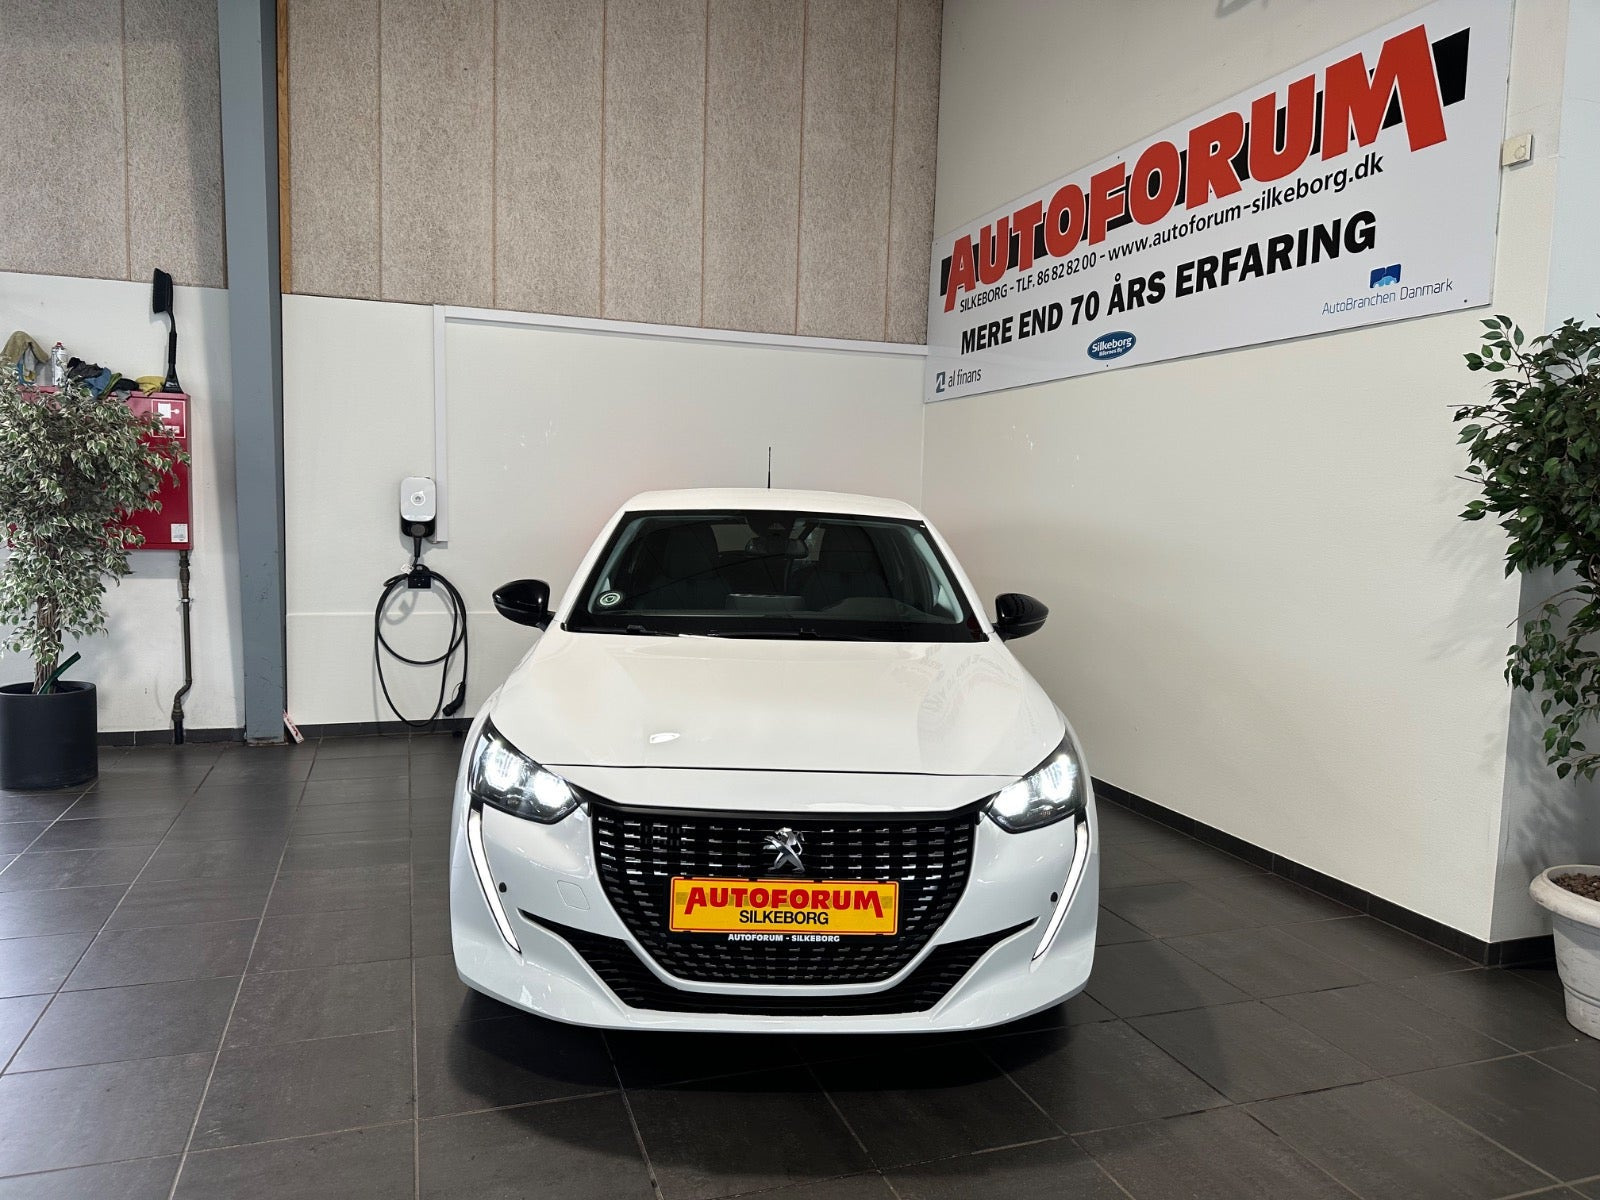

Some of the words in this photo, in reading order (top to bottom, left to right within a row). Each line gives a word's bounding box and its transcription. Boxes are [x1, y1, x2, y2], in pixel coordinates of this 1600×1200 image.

[944, 24, 1447, 314] AUTOFORUM
[960, 283, 1008, 313] SILKEBORG
[1016, 274, 1035, 293] TLF.
[1108, 152, 1384, 261] www.autoforum-silkeborg.dk
[960, 315, 1014, 355] MERE
[1018, 302, 1063, 340] END
[1070, 290, 1100, 326] 70
[1107, 272, 1166, 317] ÅRS
[1175, 210, 1377, 298] ERFARING
[1321, 292, 1396, 316] AutoBranchen
[1400, 277, 1453, 301] Danmark
[1091, 337, 1133, 353] Silkeborg
[948, 370, 956, 388] al
[957, 368, 982, 386] finans
[684, 887, 884, 919] AUTOFORUM
[739, 909, 829, 925] SILKEBORG
[727, 933, 784, 942] AUTOFORUM
[791, 934, 840, 943] SILKEBORG
